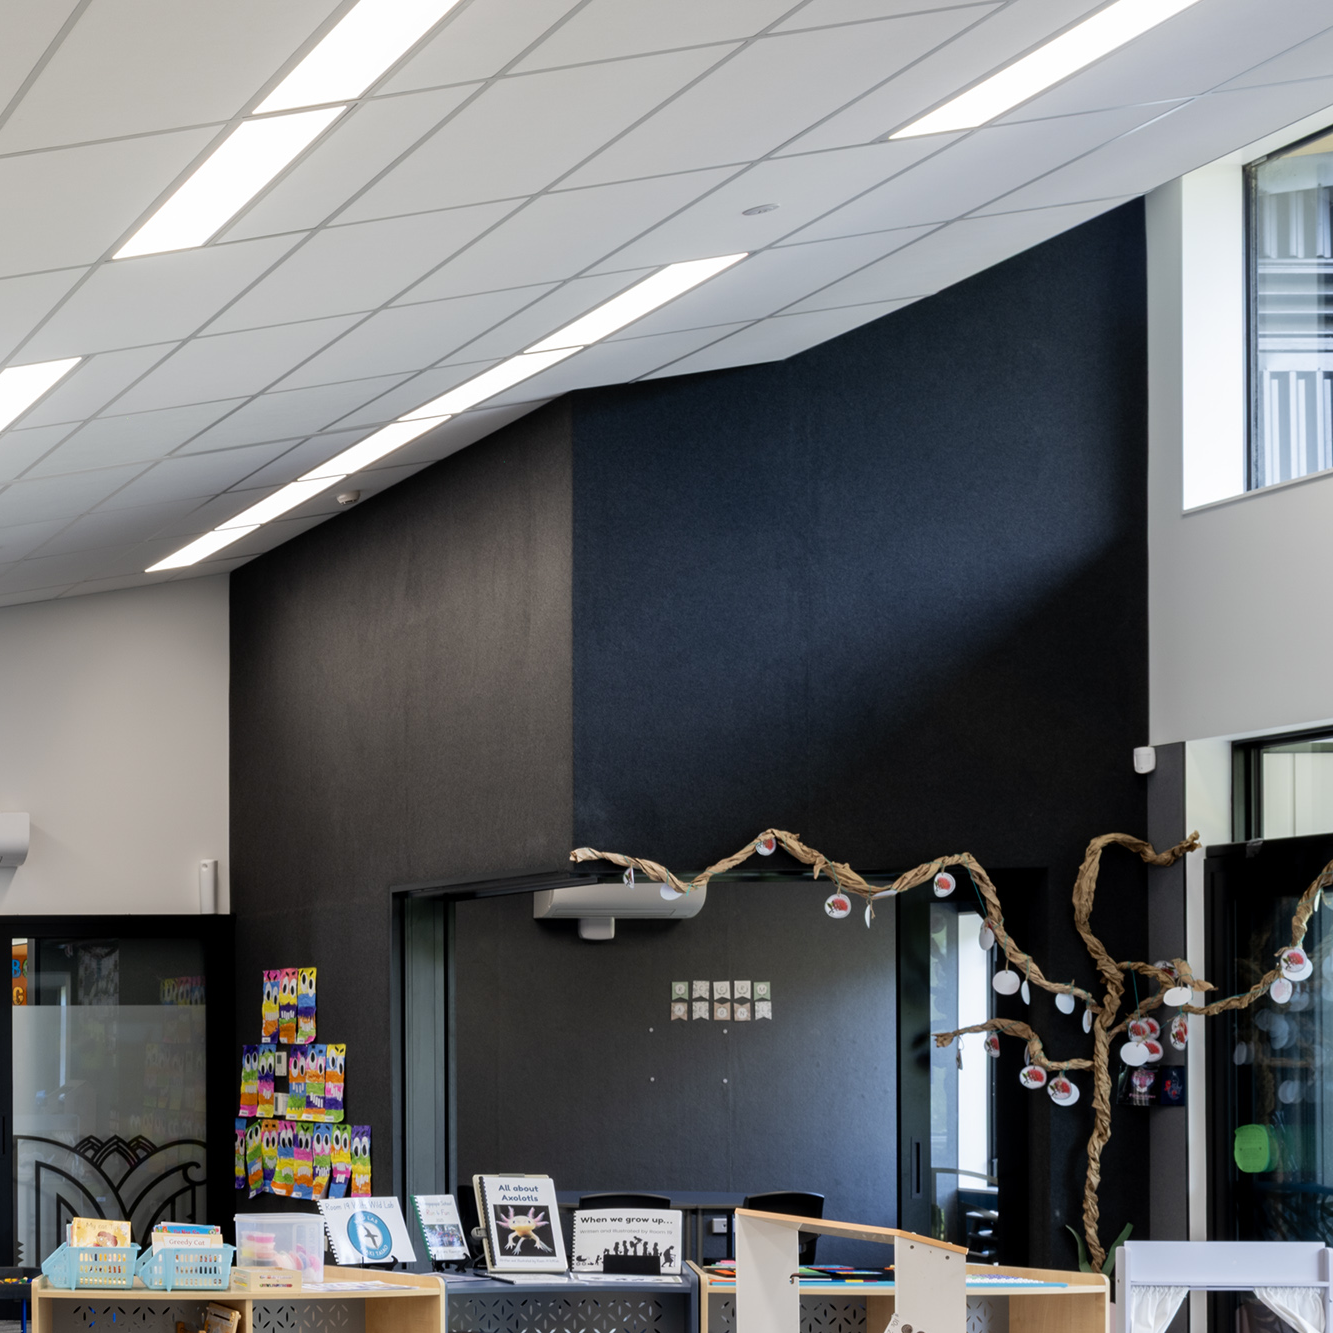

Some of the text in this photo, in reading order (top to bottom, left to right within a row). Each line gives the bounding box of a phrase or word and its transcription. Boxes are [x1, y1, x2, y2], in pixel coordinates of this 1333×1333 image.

[498, 1184, 539, 1193] All about
[501, 1194, 539, 1202] Axolotls
[370, 1201, 382, 1209] Wild
[384, 1200, 394, 1209] Lab
[580, 1216, 607, 1224] When
[625, 1217, 649, 1225] grow
[651, 1217, 673, 1225] up...
[86, 1222, 97, 1230] My
